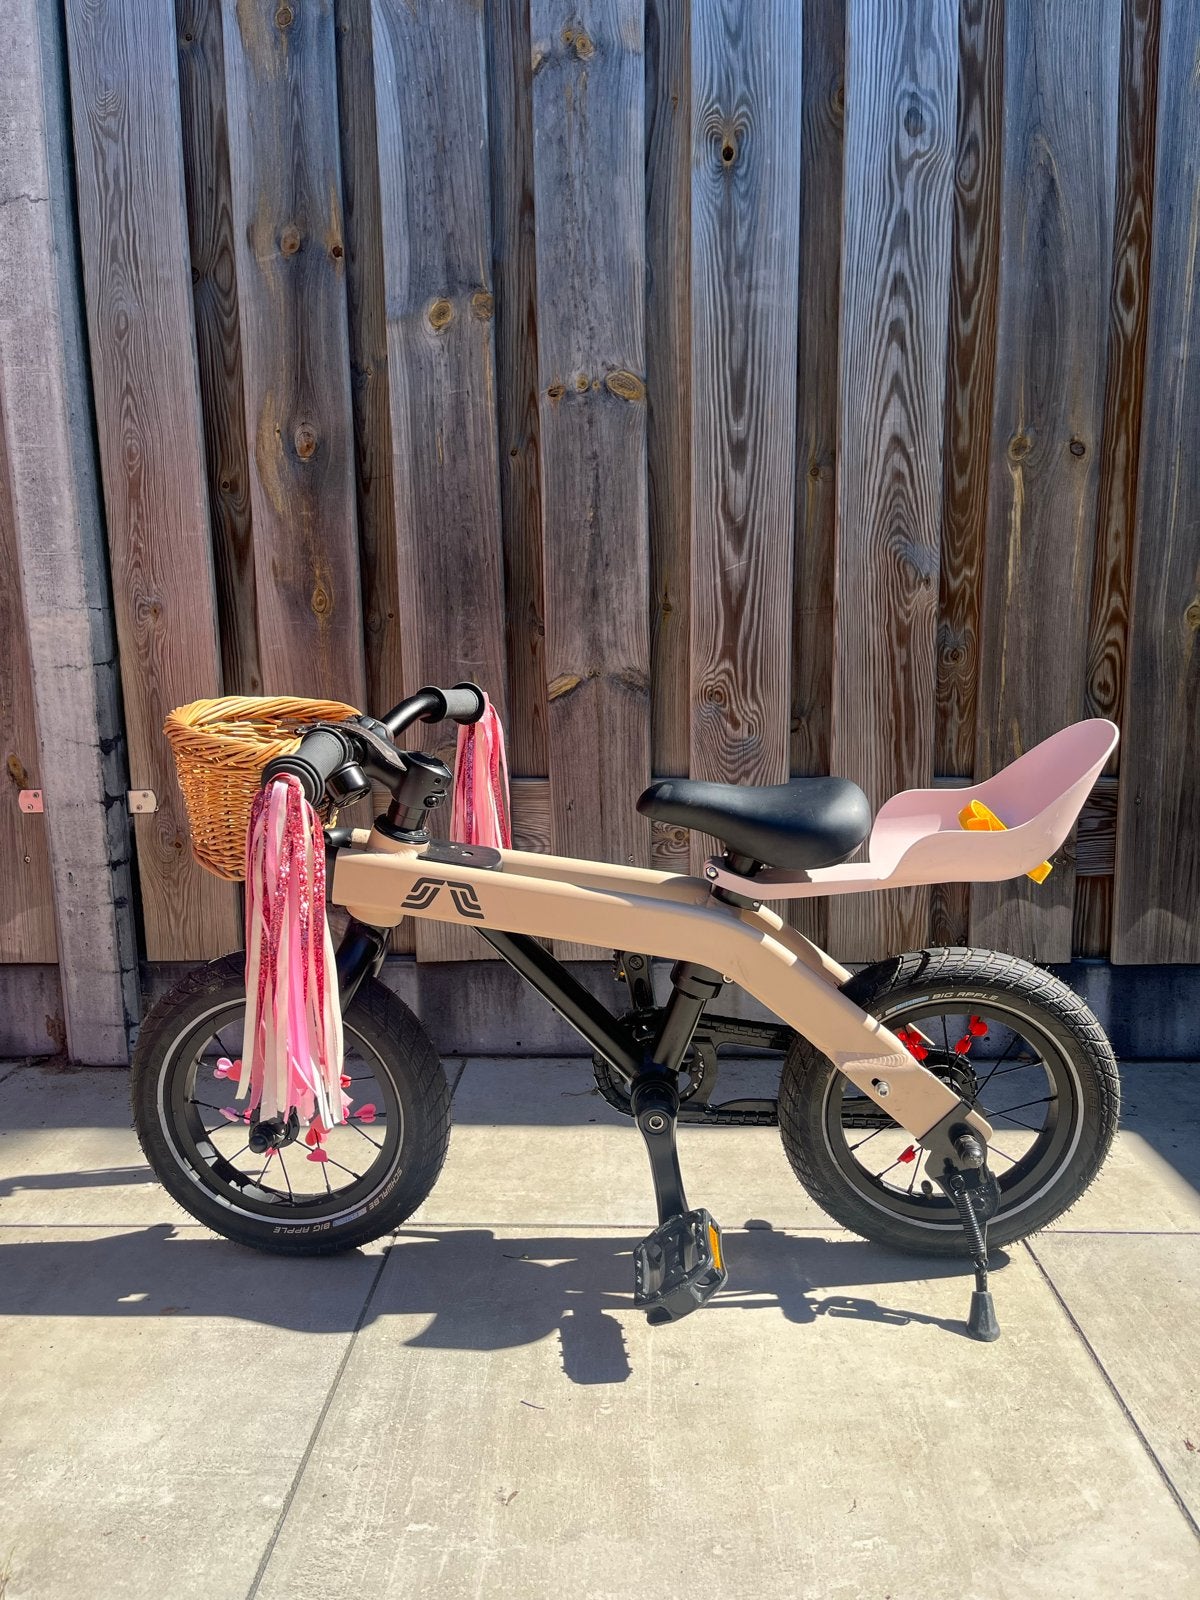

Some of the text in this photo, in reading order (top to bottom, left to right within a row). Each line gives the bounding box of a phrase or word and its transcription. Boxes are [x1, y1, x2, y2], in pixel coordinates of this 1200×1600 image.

[931, 991, 999, 1001] BIG APPLE
[368, 1166, 403, 1211] SCHWALBE
[273, 1221, 331, 1234] BIG APPLE
